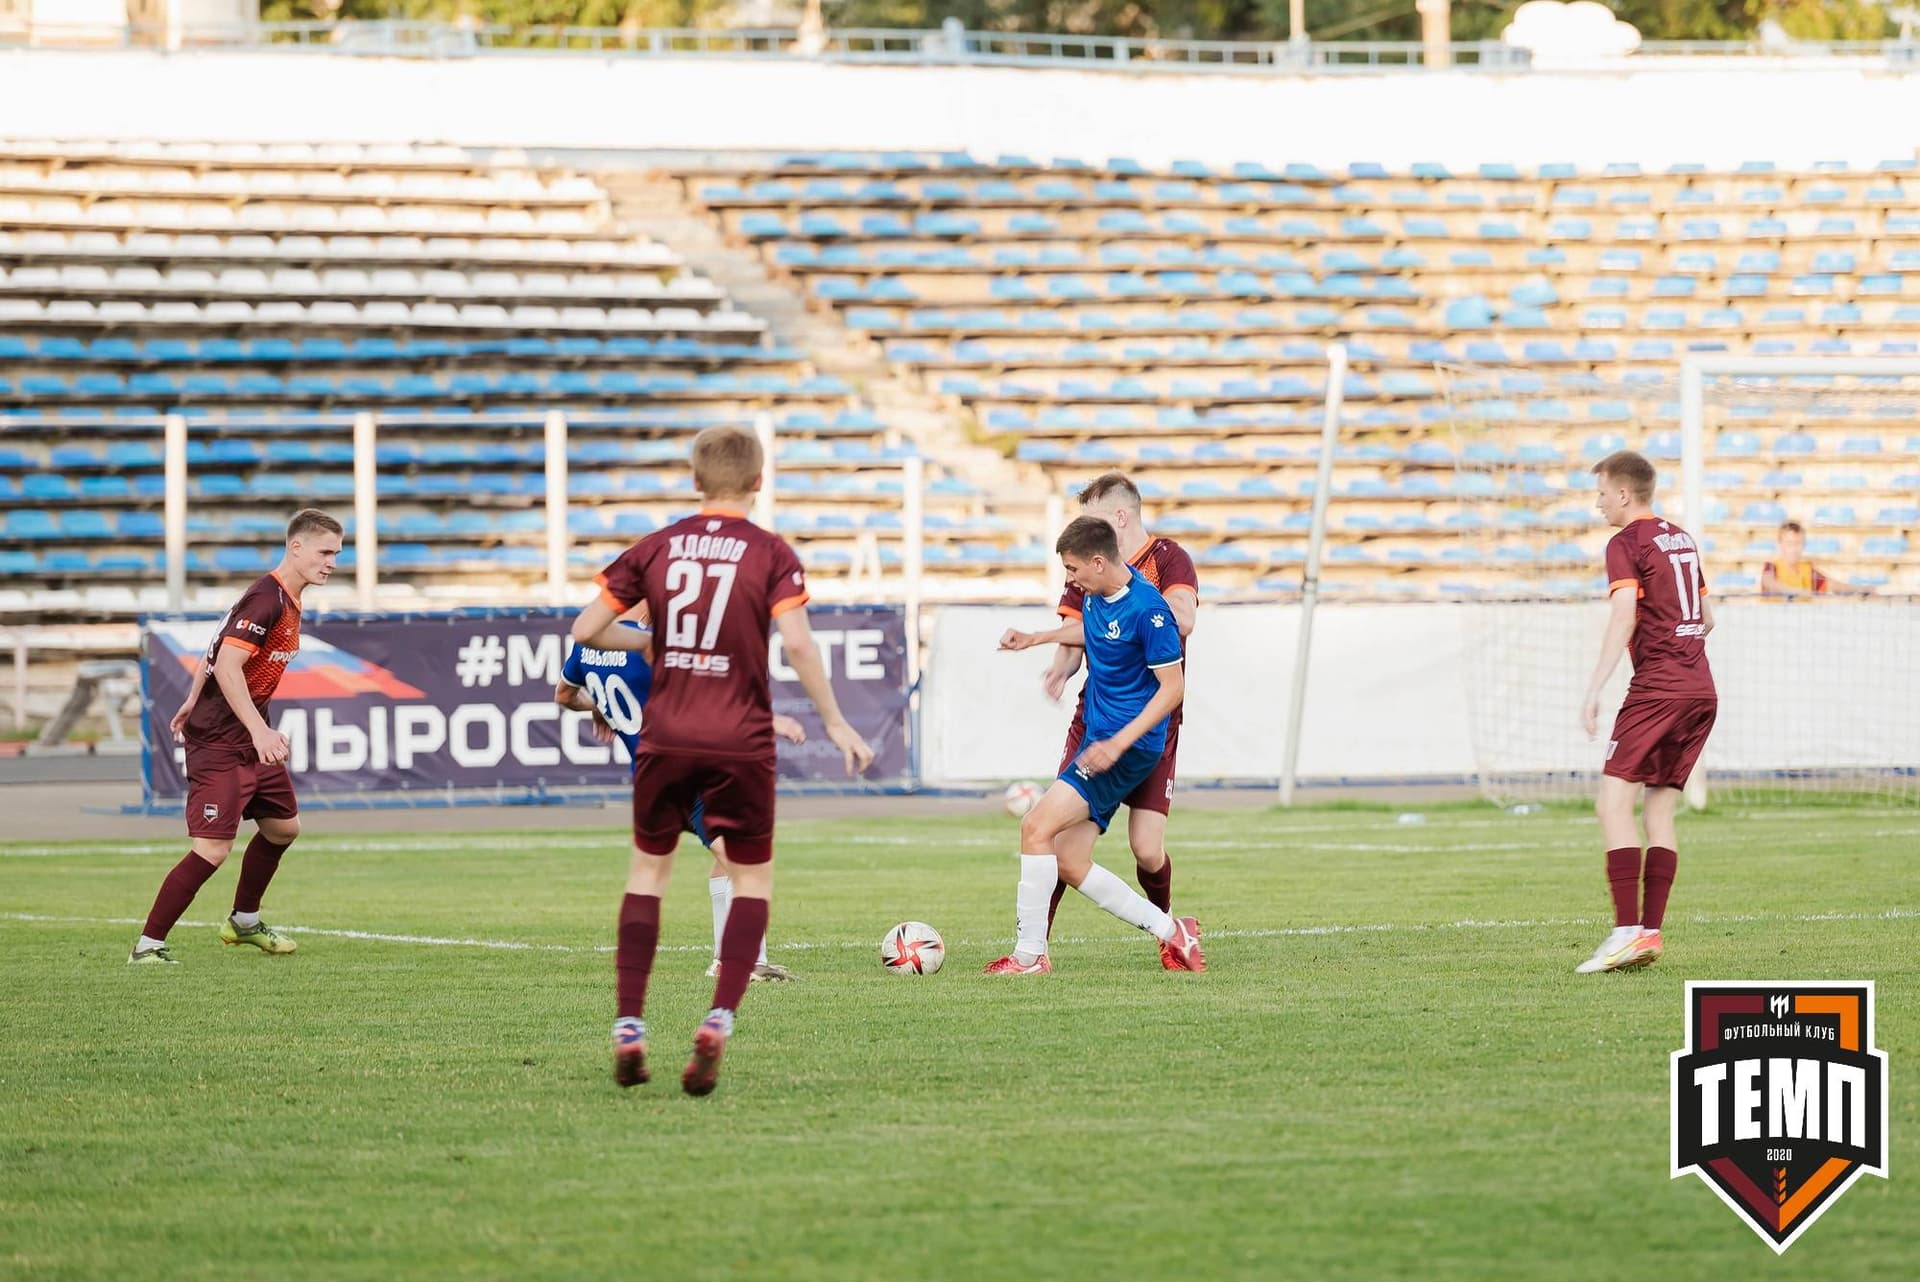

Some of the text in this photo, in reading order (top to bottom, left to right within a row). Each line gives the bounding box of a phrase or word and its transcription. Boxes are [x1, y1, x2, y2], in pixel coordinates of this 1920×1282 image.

[668, 534, 748, 562] ЖДАНОВ
[665, 560, 738, 650] 27
[1668, 551, 1701, 621] 17
[664, 651, 730, 672] SEUS
[585, 671, 643, 735] 20
